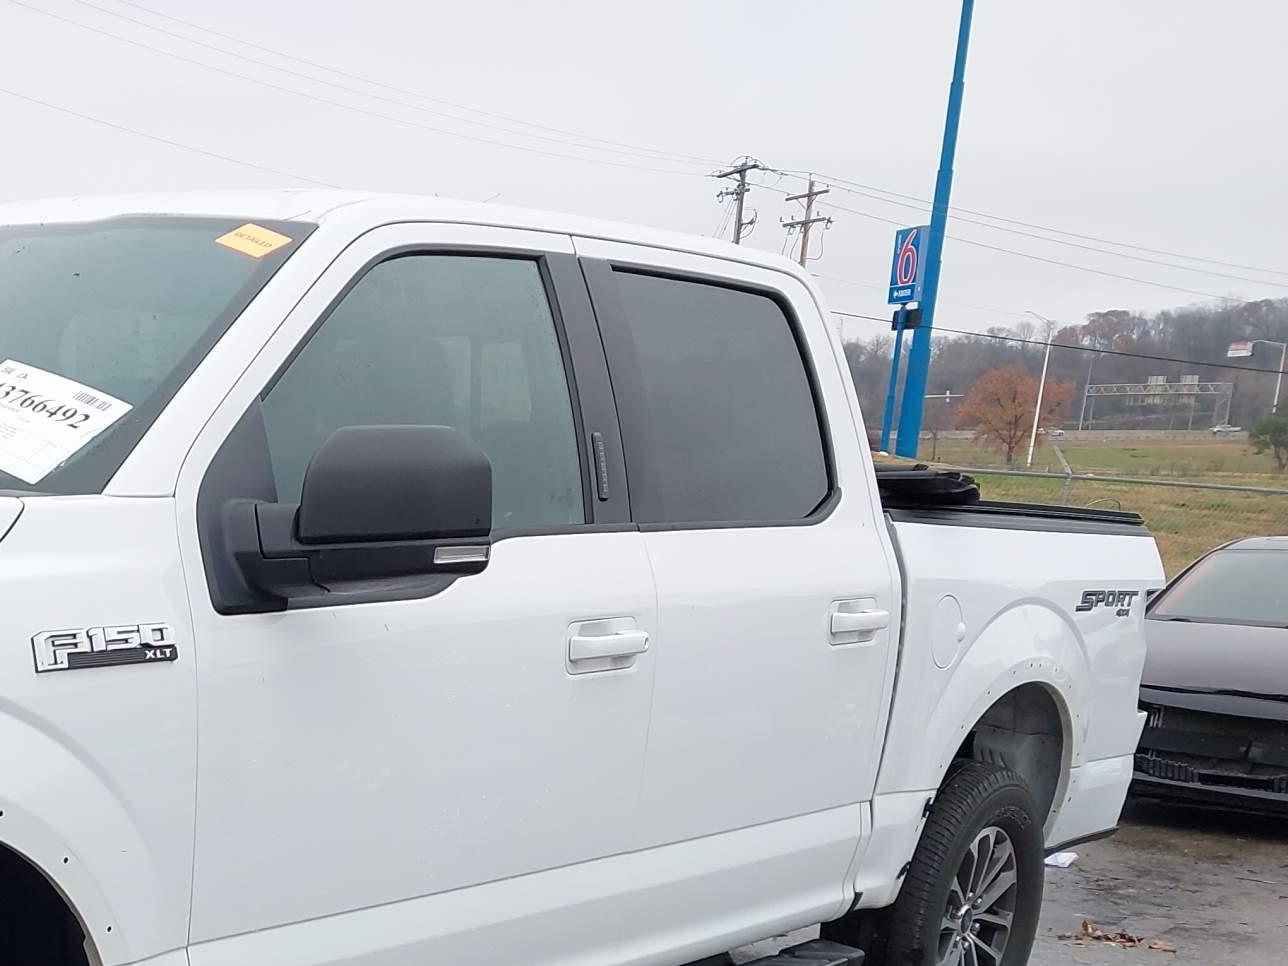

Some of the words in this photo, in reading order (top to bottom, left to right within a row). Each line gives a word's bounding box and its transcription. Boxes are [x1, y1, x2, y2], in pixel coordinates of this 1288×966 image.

[897, 229, 917, 286] 6
[1075, 590, 1139, 612] SPORT
[145, 648, 173, 660] XLT
